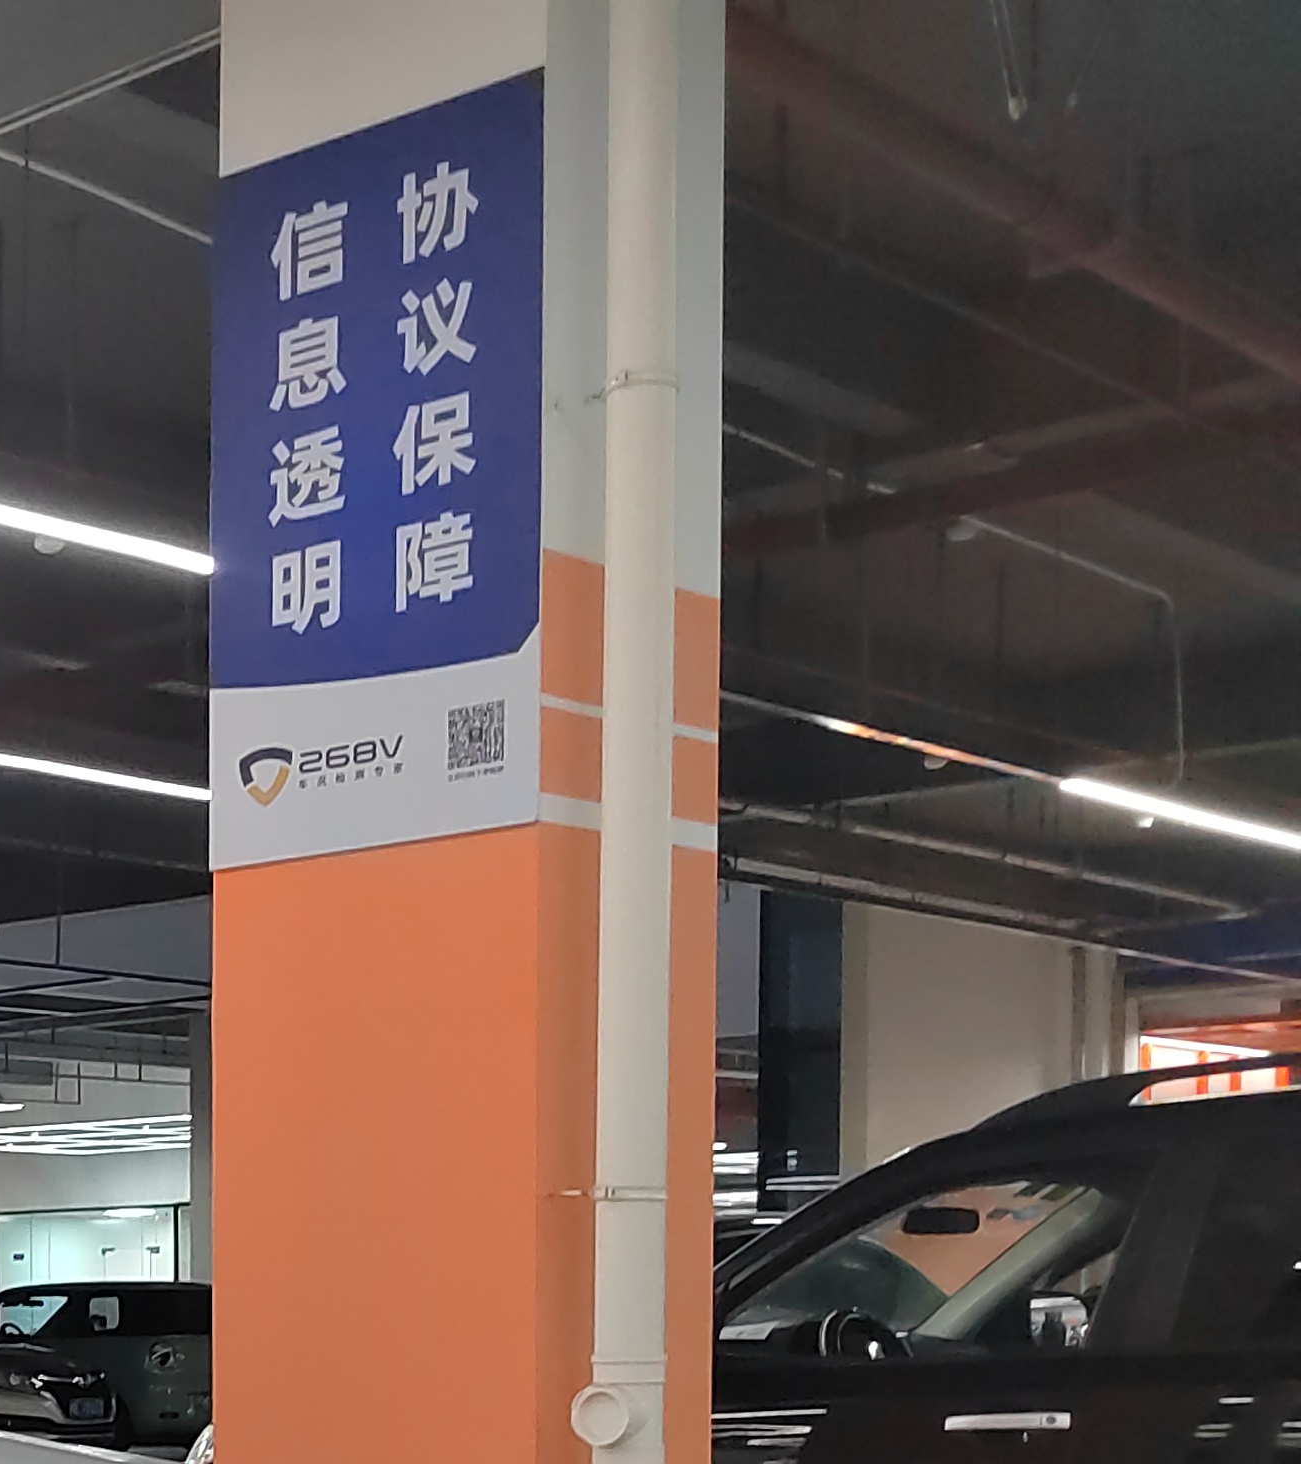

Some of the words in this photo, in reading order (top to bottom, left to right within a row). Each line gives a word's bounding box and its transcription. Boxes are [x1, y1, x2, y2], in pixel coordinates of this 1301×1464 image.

[270, 200, 349, 636] 信息透明
[393, 161, 478, 613] 协议保障
[299, 734, 403, 774] 268V
